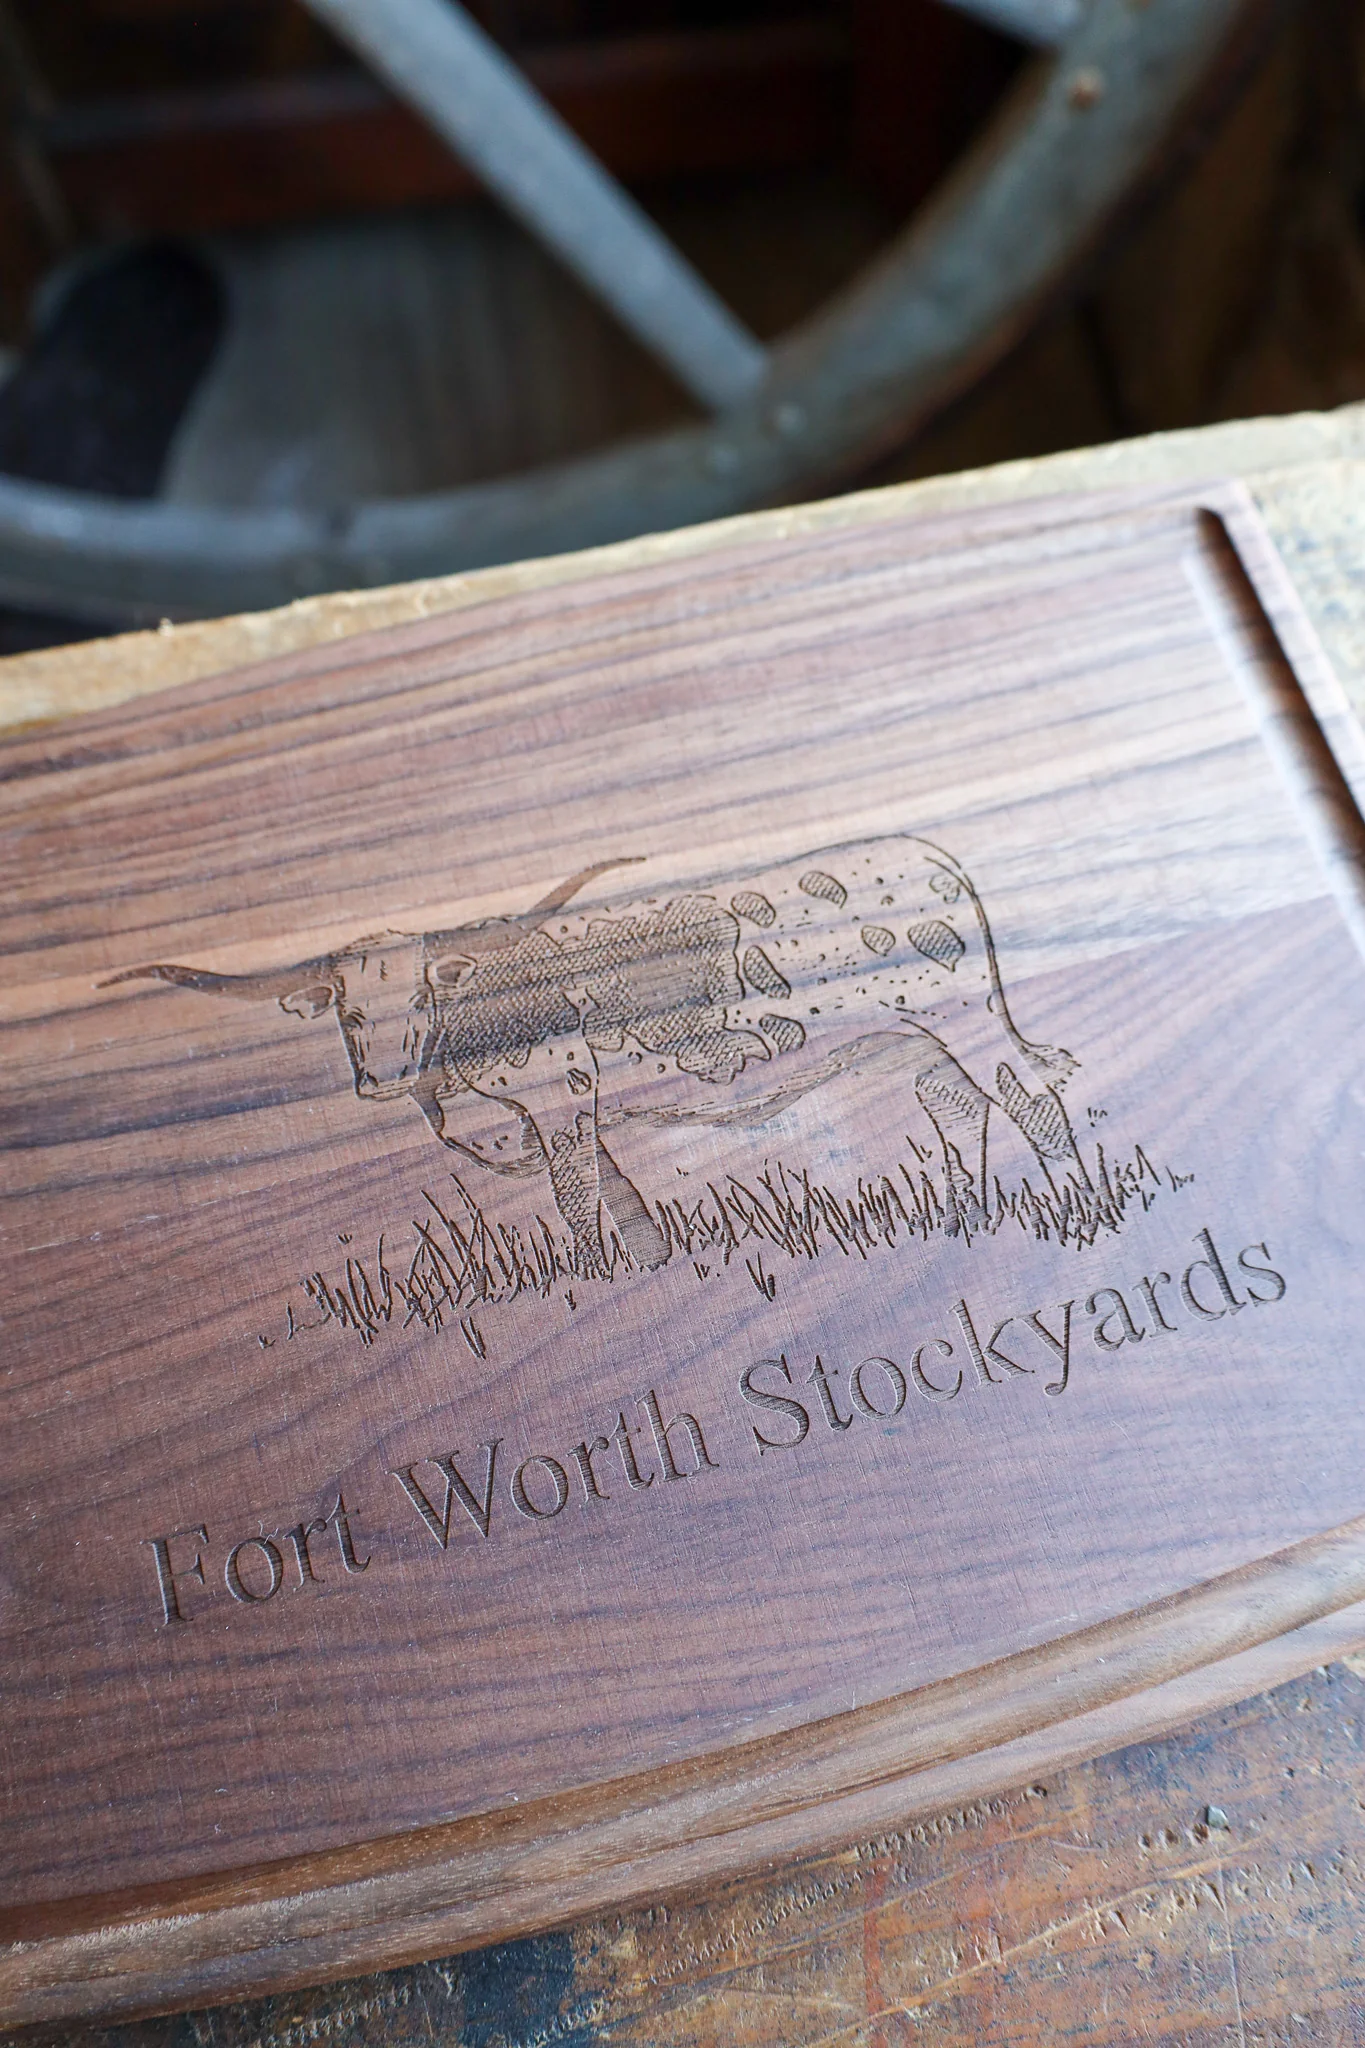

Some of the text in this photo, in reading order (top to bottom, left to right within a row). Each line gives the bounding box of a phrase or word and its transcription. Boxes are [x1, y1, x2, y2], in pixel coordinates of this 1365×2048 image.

[146, 1227, 1287, 1627] Fort Worth Stockyards
